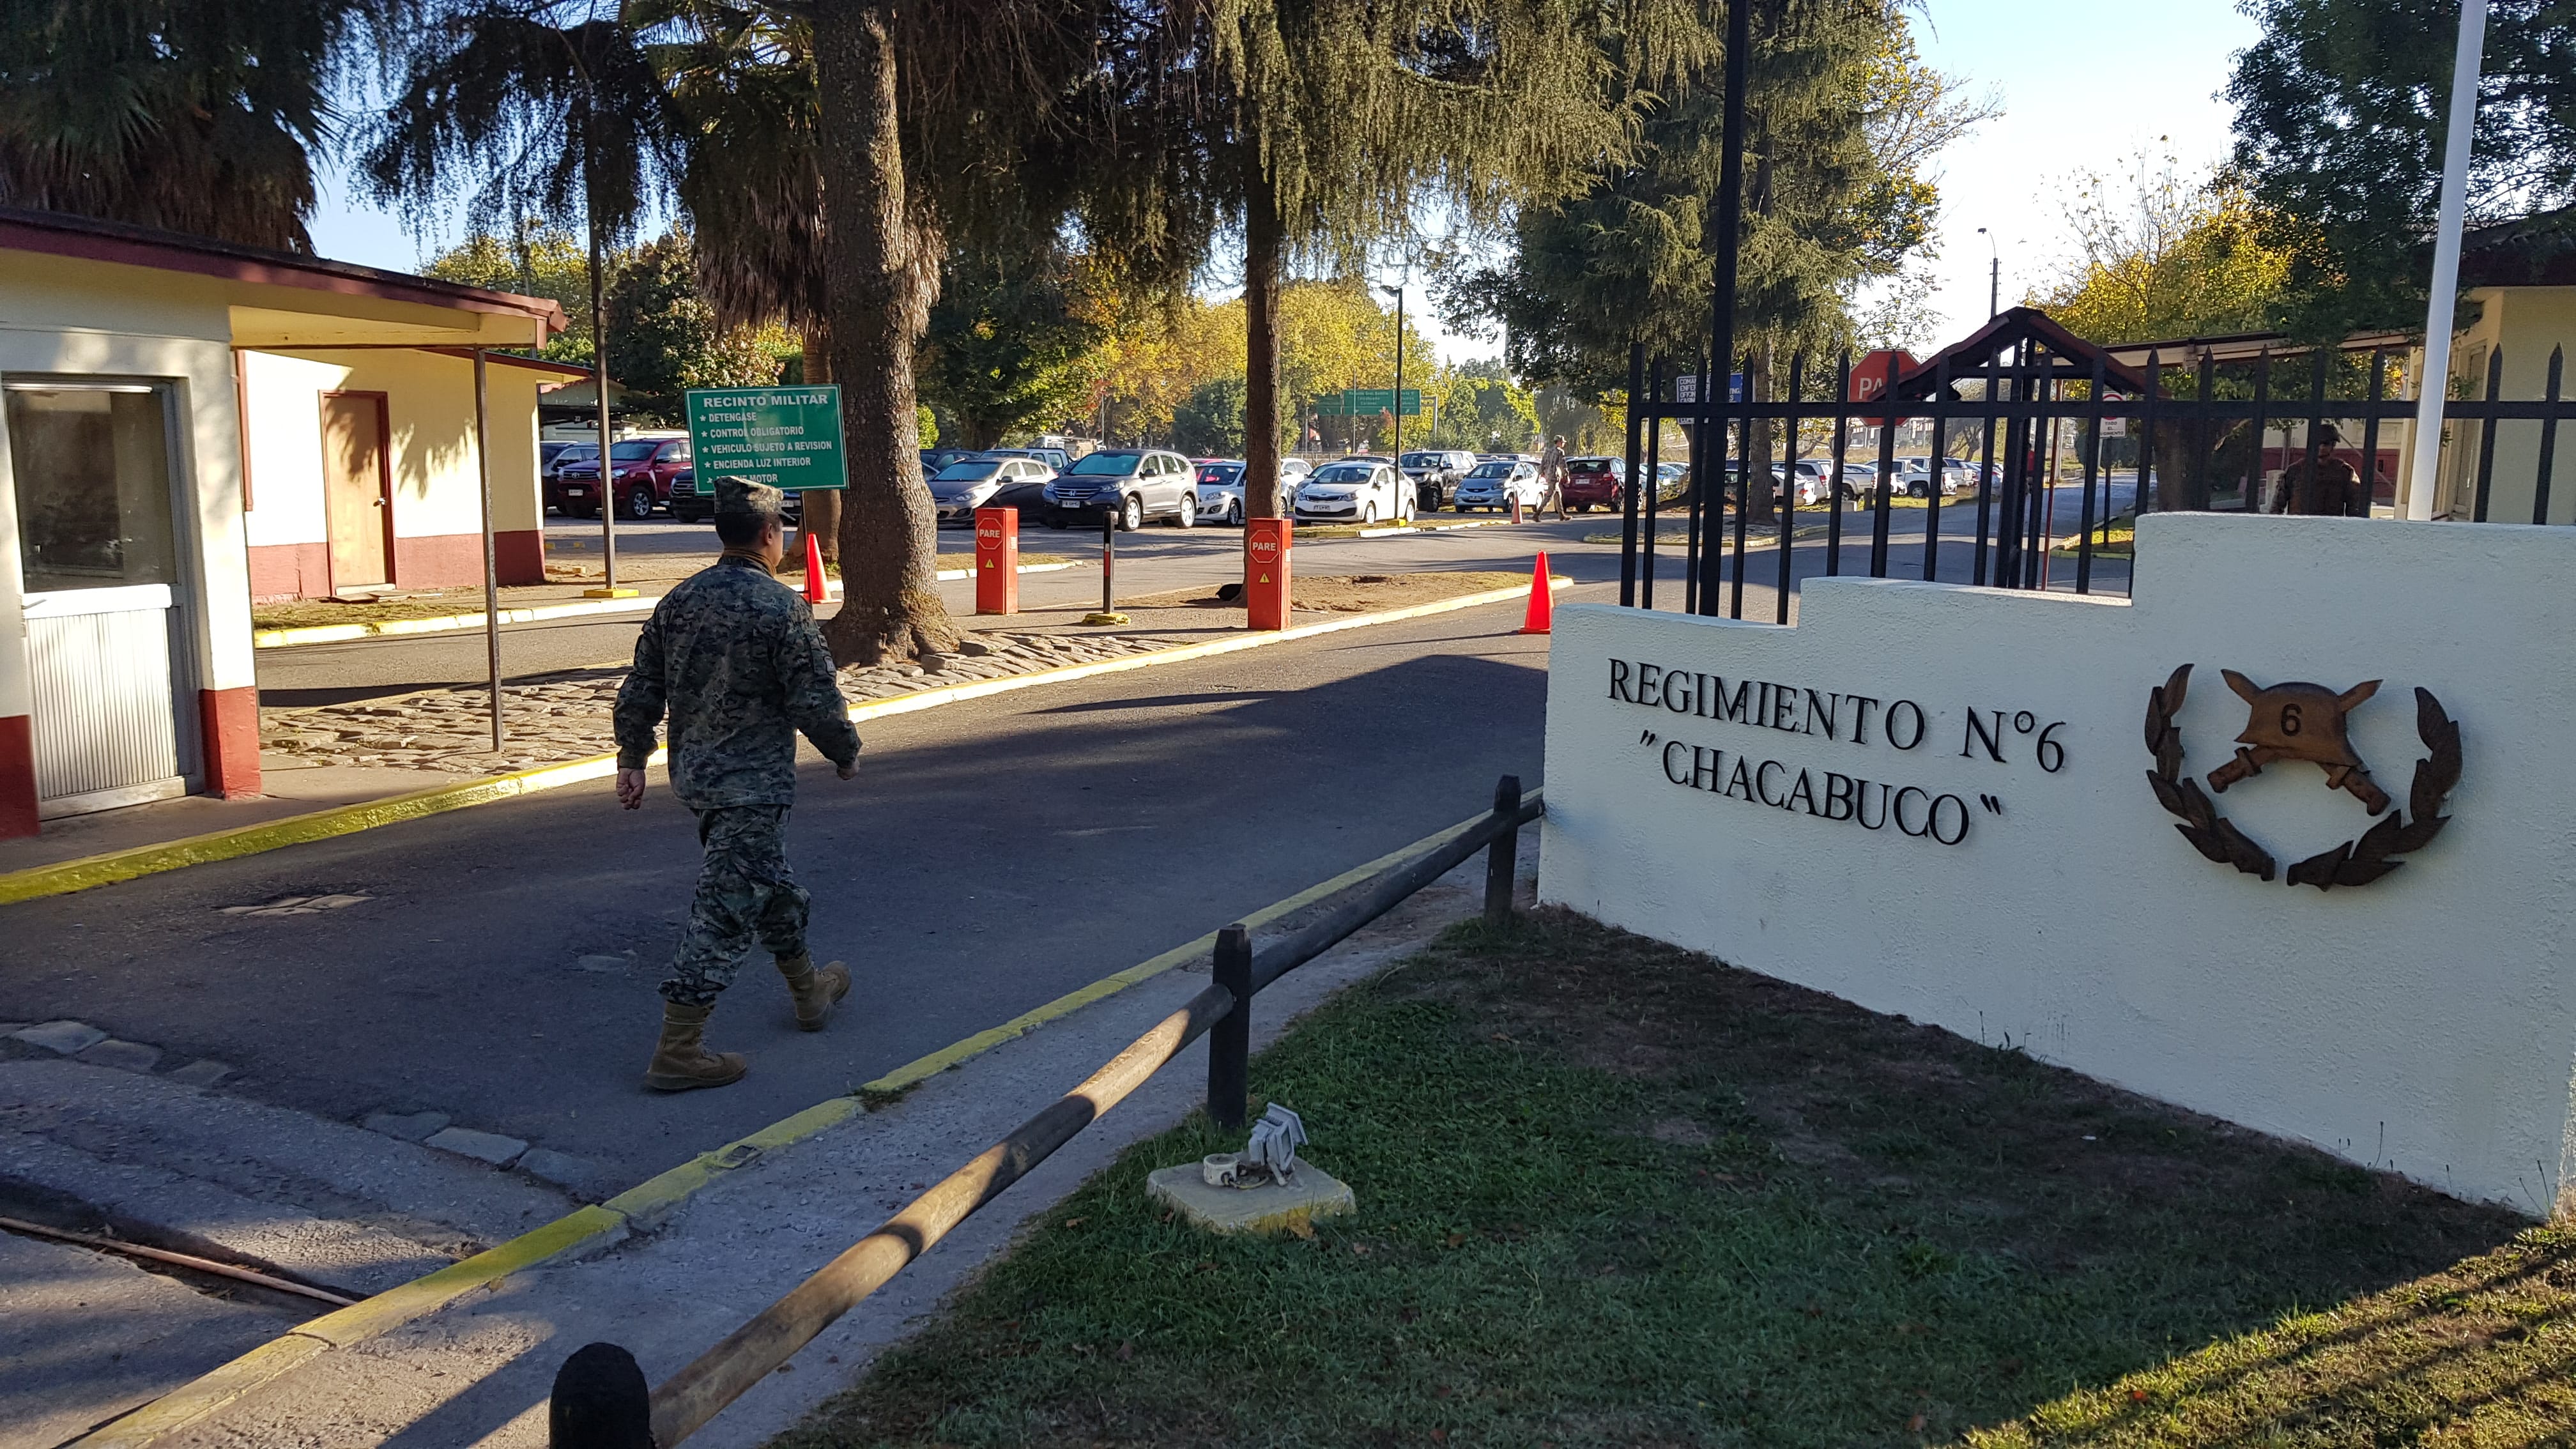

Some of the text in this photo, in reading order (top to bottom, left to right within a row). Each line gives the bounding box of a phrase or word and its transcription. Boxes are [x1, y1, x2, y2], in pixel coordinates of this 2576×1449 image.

[703, 394, 828, 408] RECINTO MILITAR
[709, 412, 756, 422] DETENGASE
[710, 425, 804, 438] CONTROL OBLIGATORIO
[710, 441, 832, 454] VEHICULO SUJETO A REVISION
[713, 457, 811, 470] ENCIENDA LUZ INTERIOR
[749, 473, 778, 483] MOTOR
[979, 528, 1000, 538] PARE
[1252, 542, 1276, 551] PARE
[1606, 657, 1926, 751] REGIMIENTO
[2280, 703, 2302, 737] 6
